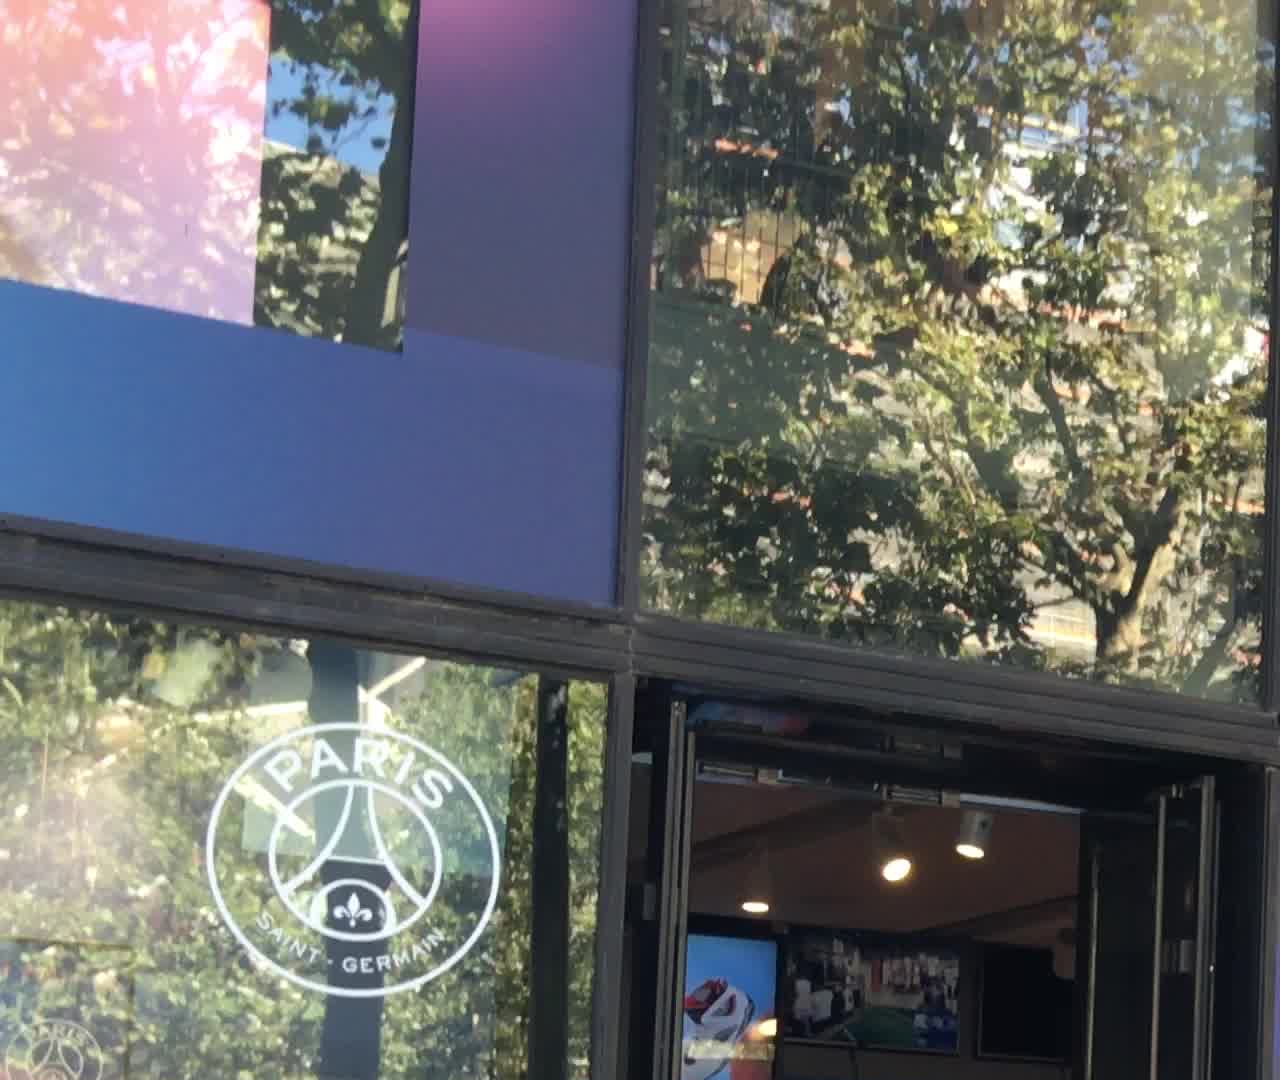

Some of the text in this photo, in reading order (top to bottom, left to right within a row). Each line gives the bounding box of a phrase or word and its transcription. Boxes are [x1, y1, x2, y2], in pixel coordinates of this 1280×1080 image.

[264, 738, 454, 809] PARIS
[256, 911, 446, 974] SAINT GERMAIN
